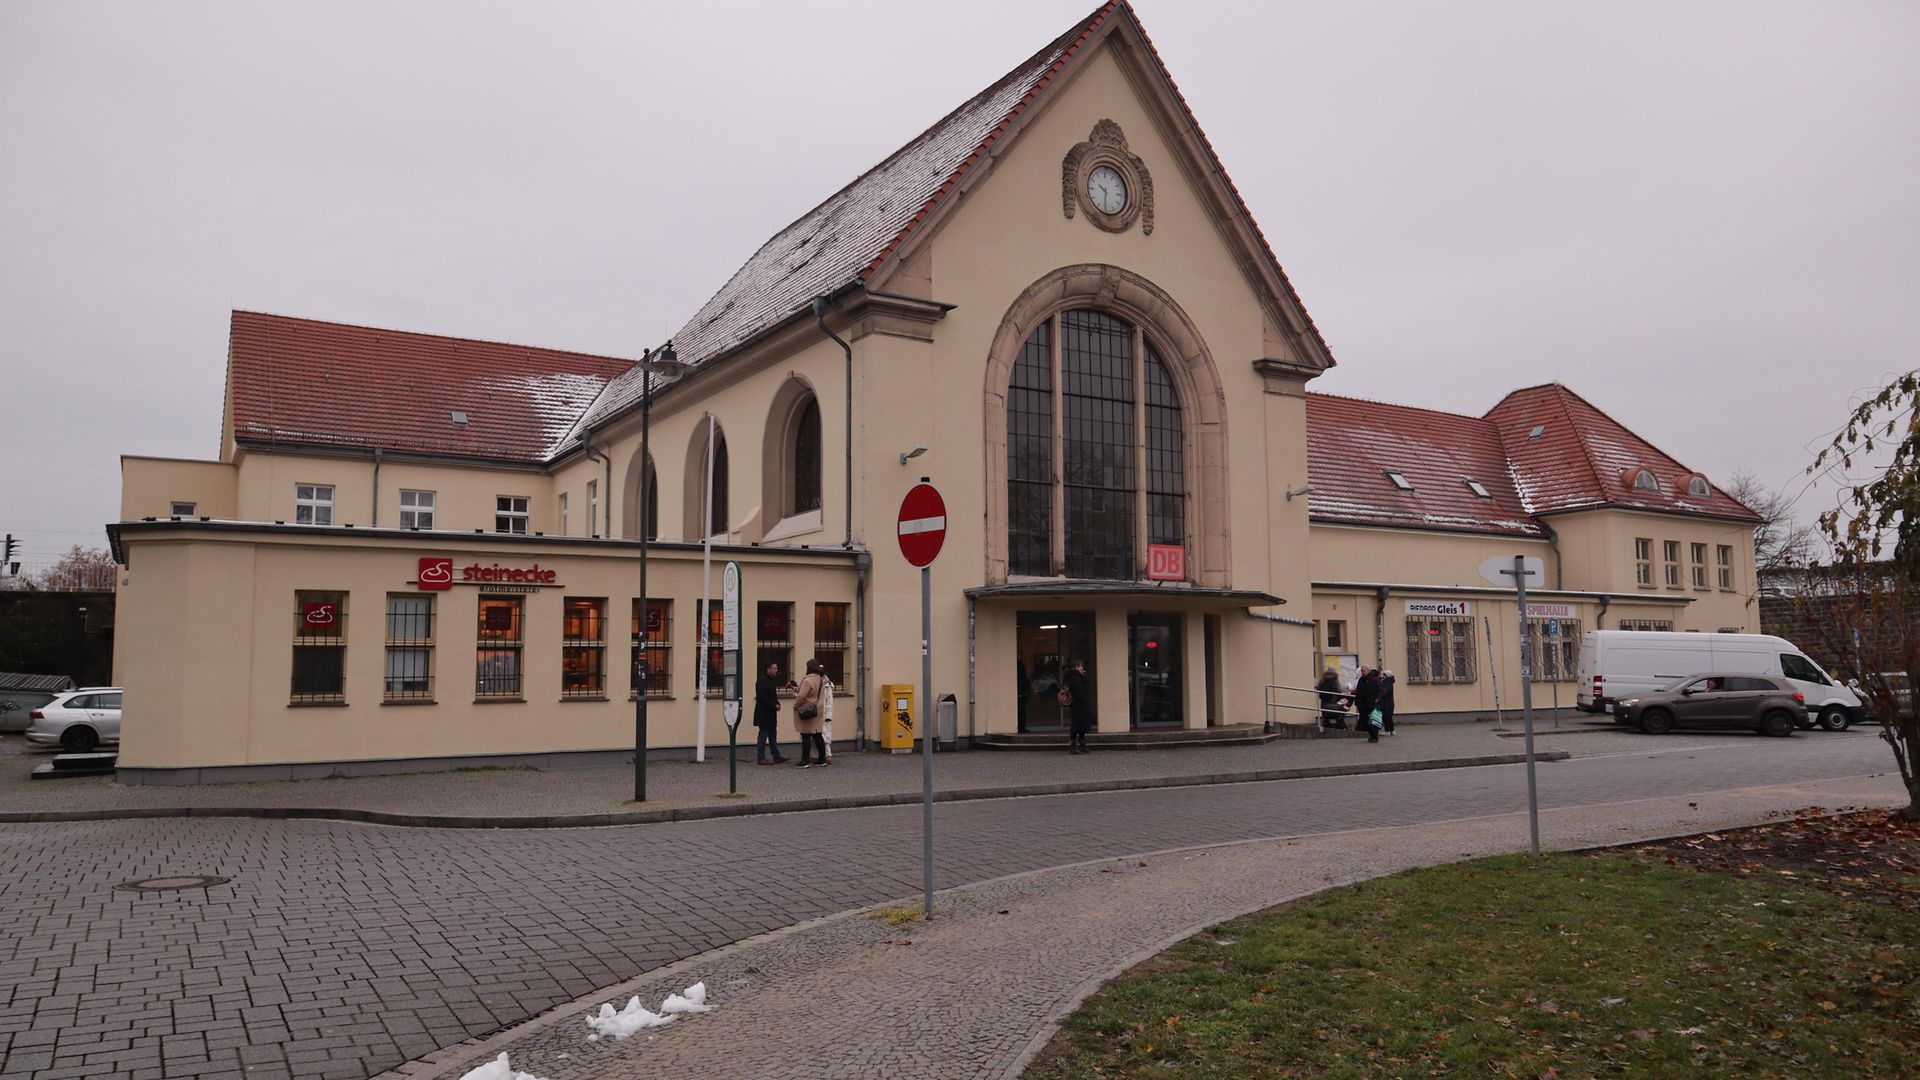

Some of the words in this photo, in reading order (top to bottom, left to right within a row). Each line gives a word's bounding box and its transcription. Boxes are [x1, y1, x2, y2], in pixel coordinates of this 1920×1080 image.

[1153, 549, 1181, 574] DB
[462, 563, 556, 583] steinecke
[1437, 602, 1458, 615] Gleis
[1459, 602, 1466, 614] 1
[1526, 604, 1569, 617] SPIELHALLE
[1551, 620, 1557, 633] P
